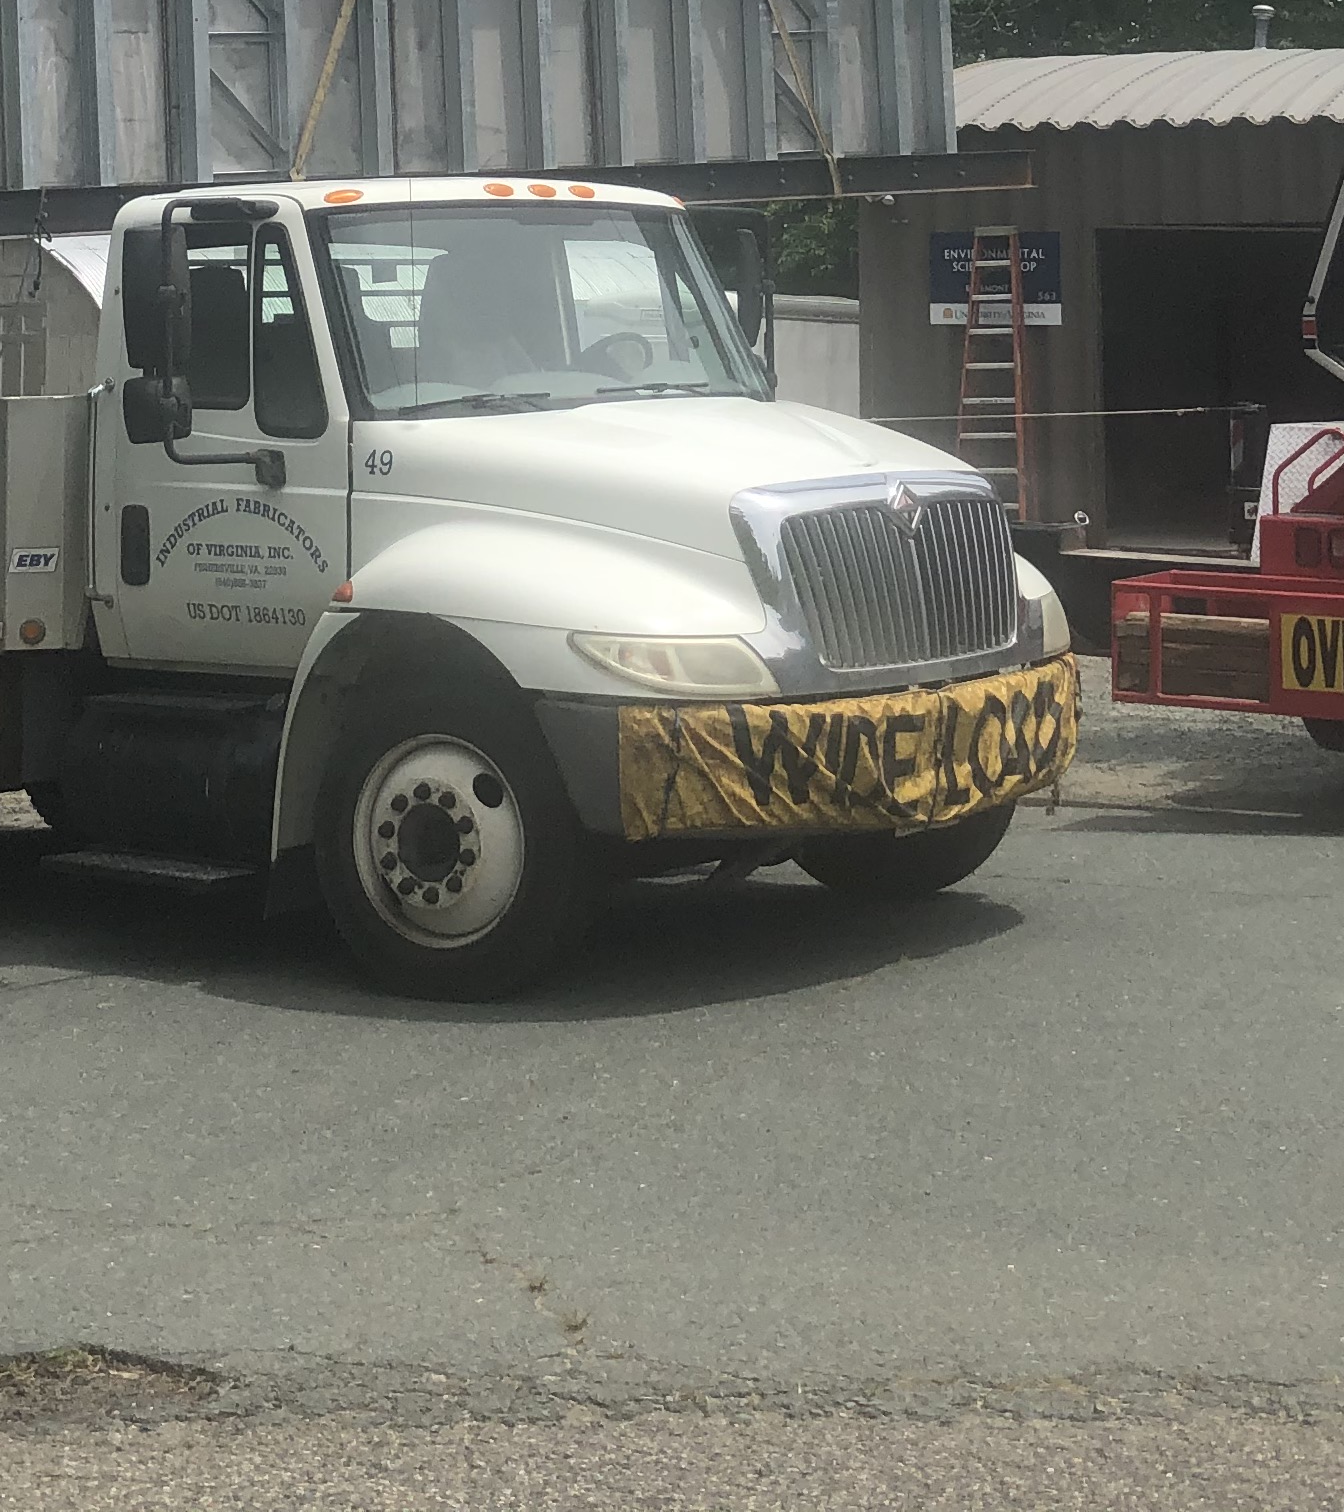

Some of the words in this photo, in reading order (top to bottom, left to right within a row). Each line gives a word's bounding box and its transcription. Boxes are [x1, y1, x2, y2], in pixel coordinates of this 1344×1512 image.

[944, 248, 1045, 260] ENVIONMTAL
[1037, 291, 1056, 301] 563
[364, 449, 393, 476] 49
[156, 499, 228, 567] INDUSTRIAL
[236, 498, 328, 573] FABRICATORS
[16, 553, 56, 567] EBY
[187, 543, 202, 555] OF
[206, 544, 264, 559] VIRGINIA,
[268, 546, 294, 559] INC.
[187, 603, 206, 619] US
[209, 603, 241, 622] DOT
[246, 606, 306, 626] 1864130
[726, 701, 928, 819] WIDE
[940, 681, 1063, 805] LOAD
